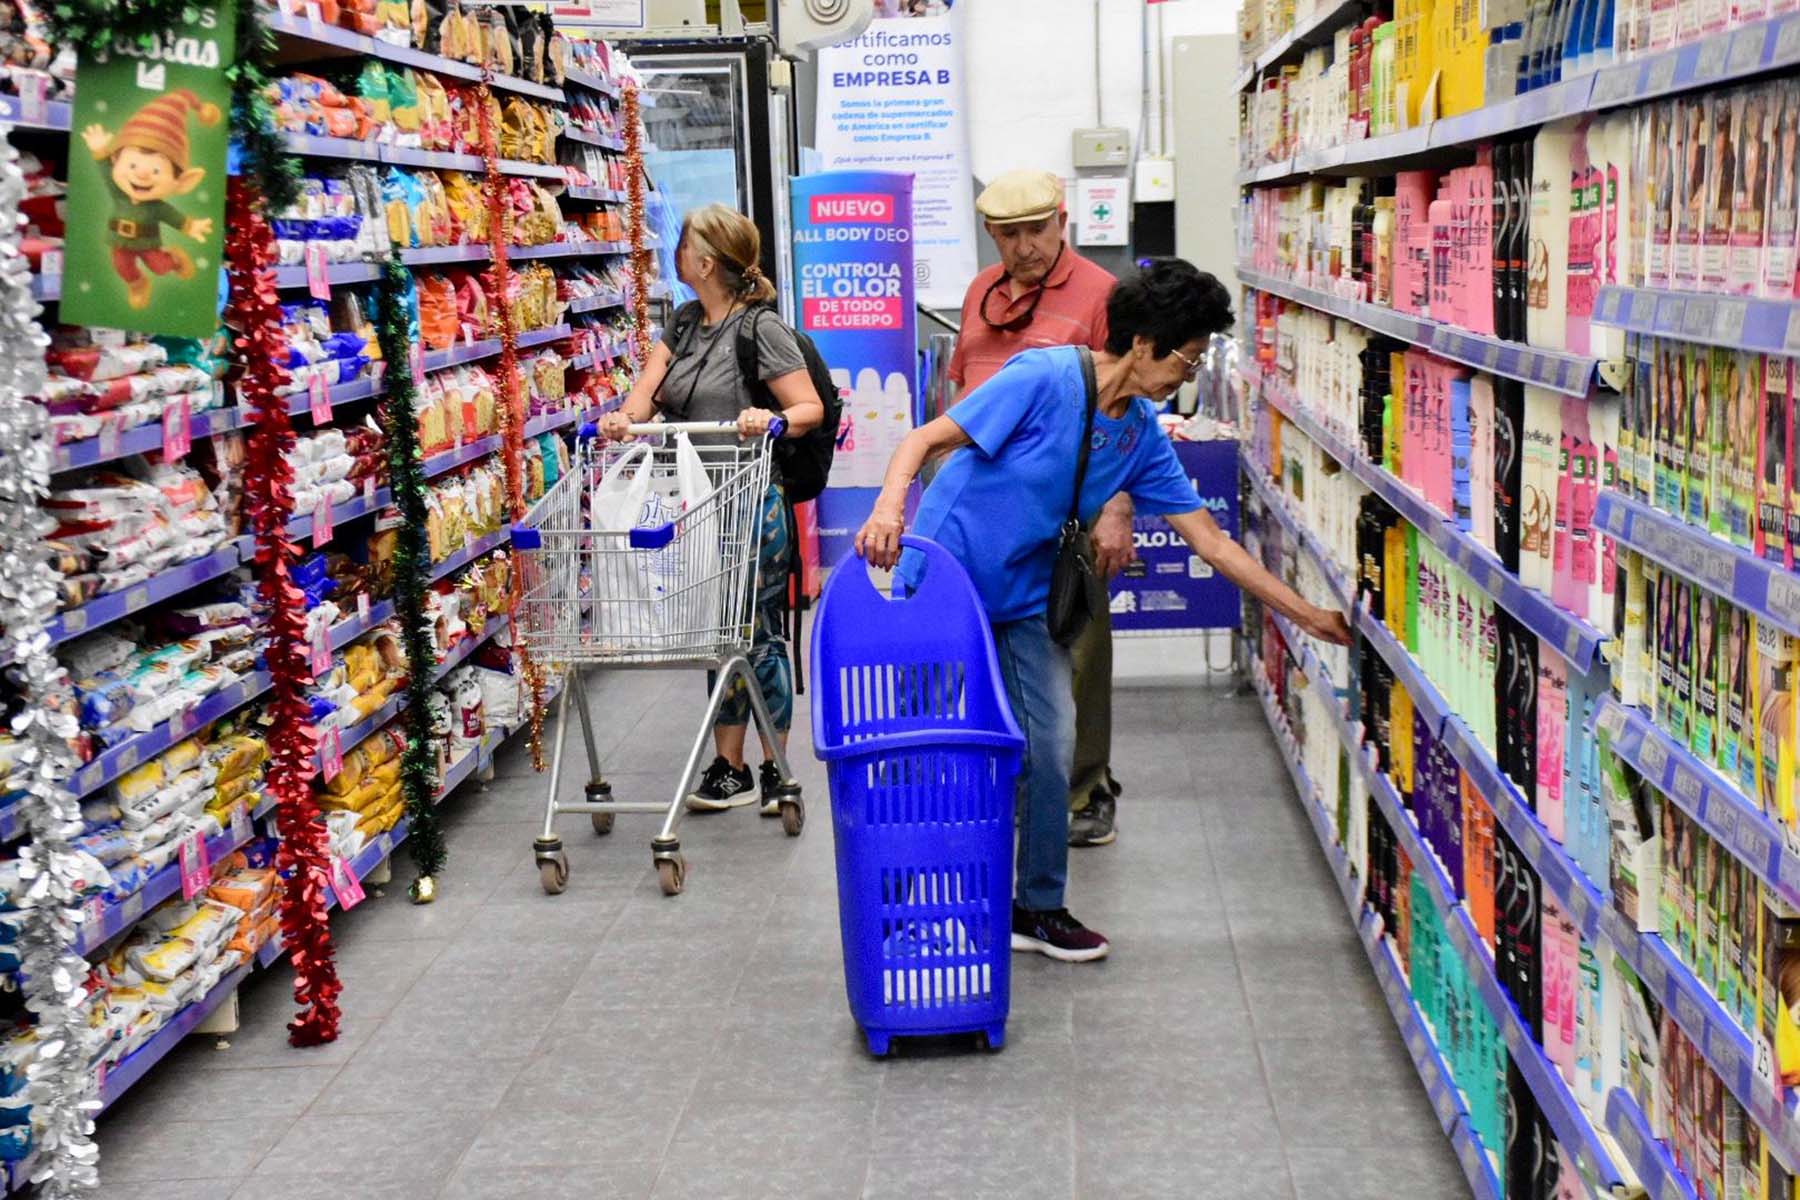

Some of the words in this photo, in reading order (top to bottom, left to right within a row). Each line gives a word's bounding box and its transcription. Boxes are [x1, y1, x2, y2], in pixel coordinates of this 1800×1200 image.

[863, 53, 918, 66] como
[833, 71, 931, 87] EMPRESA
[937, 70, 950, 85] B
[840, 100, 871, 108] Somos
[874, 99, 882, 107] la
[884, 99, 921, 109] primera
[923, 98, 945, 108] gran
[832, 111, 866, 120] cadena
[867, 110, 878, 119] de
[881, 109, 953, 120] supermercados
[837, 122, 849, 131] de
[892, 122, 903, 130] en
[906, 120, 948, 129] certificar
[853, 134, 879, 143] como
[881, 132, 922, 143] Empresa
[817, 200, 886, 217] NUEVO
[793, 229, 823, 243] ALL
[825, 227, 871, 242] BODY
[874, 228, 910, 243] DEO
[801, 263, 902, 278] CONTROLA
[801, 279, 829, 298] EL
[832, 278, 902, 298] OLOR
[820, 300, 839, 313] DE
[842, 300, 886, 313] TODO
[812, 314, 830, 327] EL
[832, 313, 894, 327] CUERPO
[1203, 497, 1230, 511] MA
